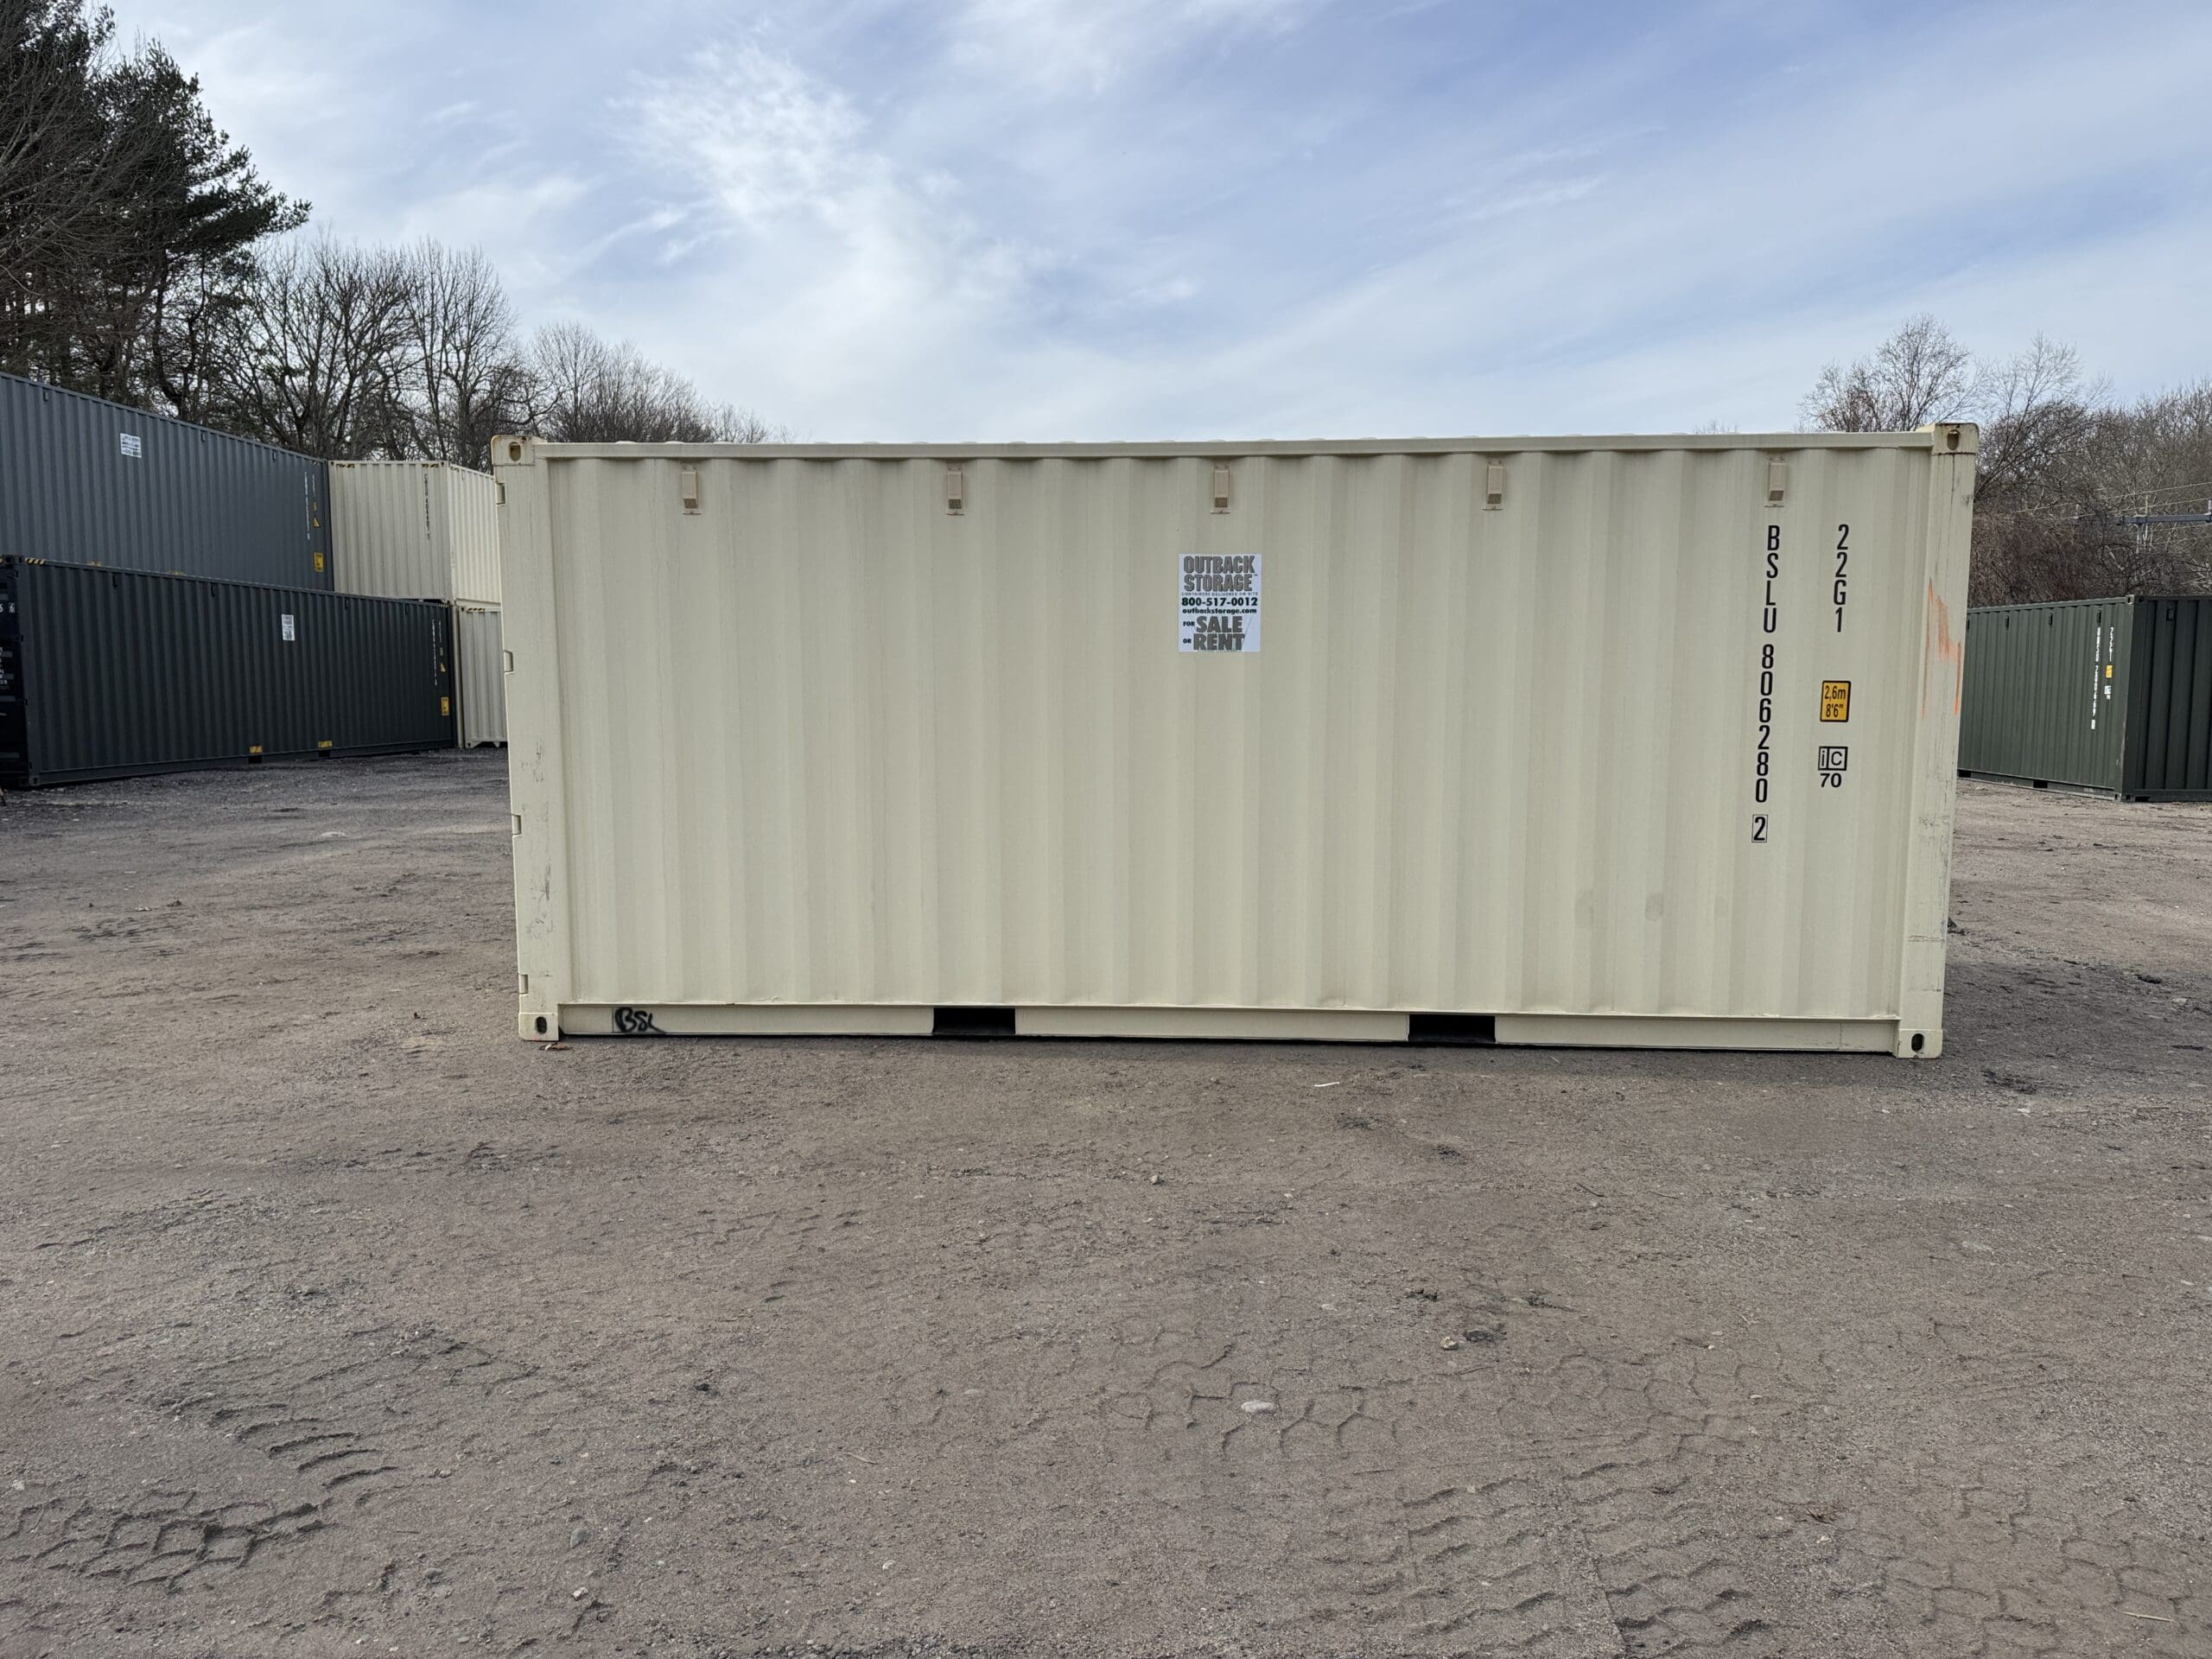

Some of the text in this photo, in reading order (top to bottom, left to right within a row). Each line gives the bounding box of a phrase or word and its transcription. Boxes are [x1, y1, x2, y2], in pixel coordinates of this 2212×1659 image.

[1183, 556, 1255, 574] OUTBACK
[1184, 574, 1253, 592] STORAGE
[1833, 524, 1849, 632] 22G1
[1181, 597, 1258, 607] 800-517-0012
[1182, 607, 1257, 615] outbackstorage.com
[1196, 616, 1243, 632] SALE
[1193, 633, 1245, 651] RENT
[1753, 524, 1780, 841] BSLU 806280 2
[1826, 703, 1844, 717] 8'6"
[1820, 772, 1842, 788] 70
